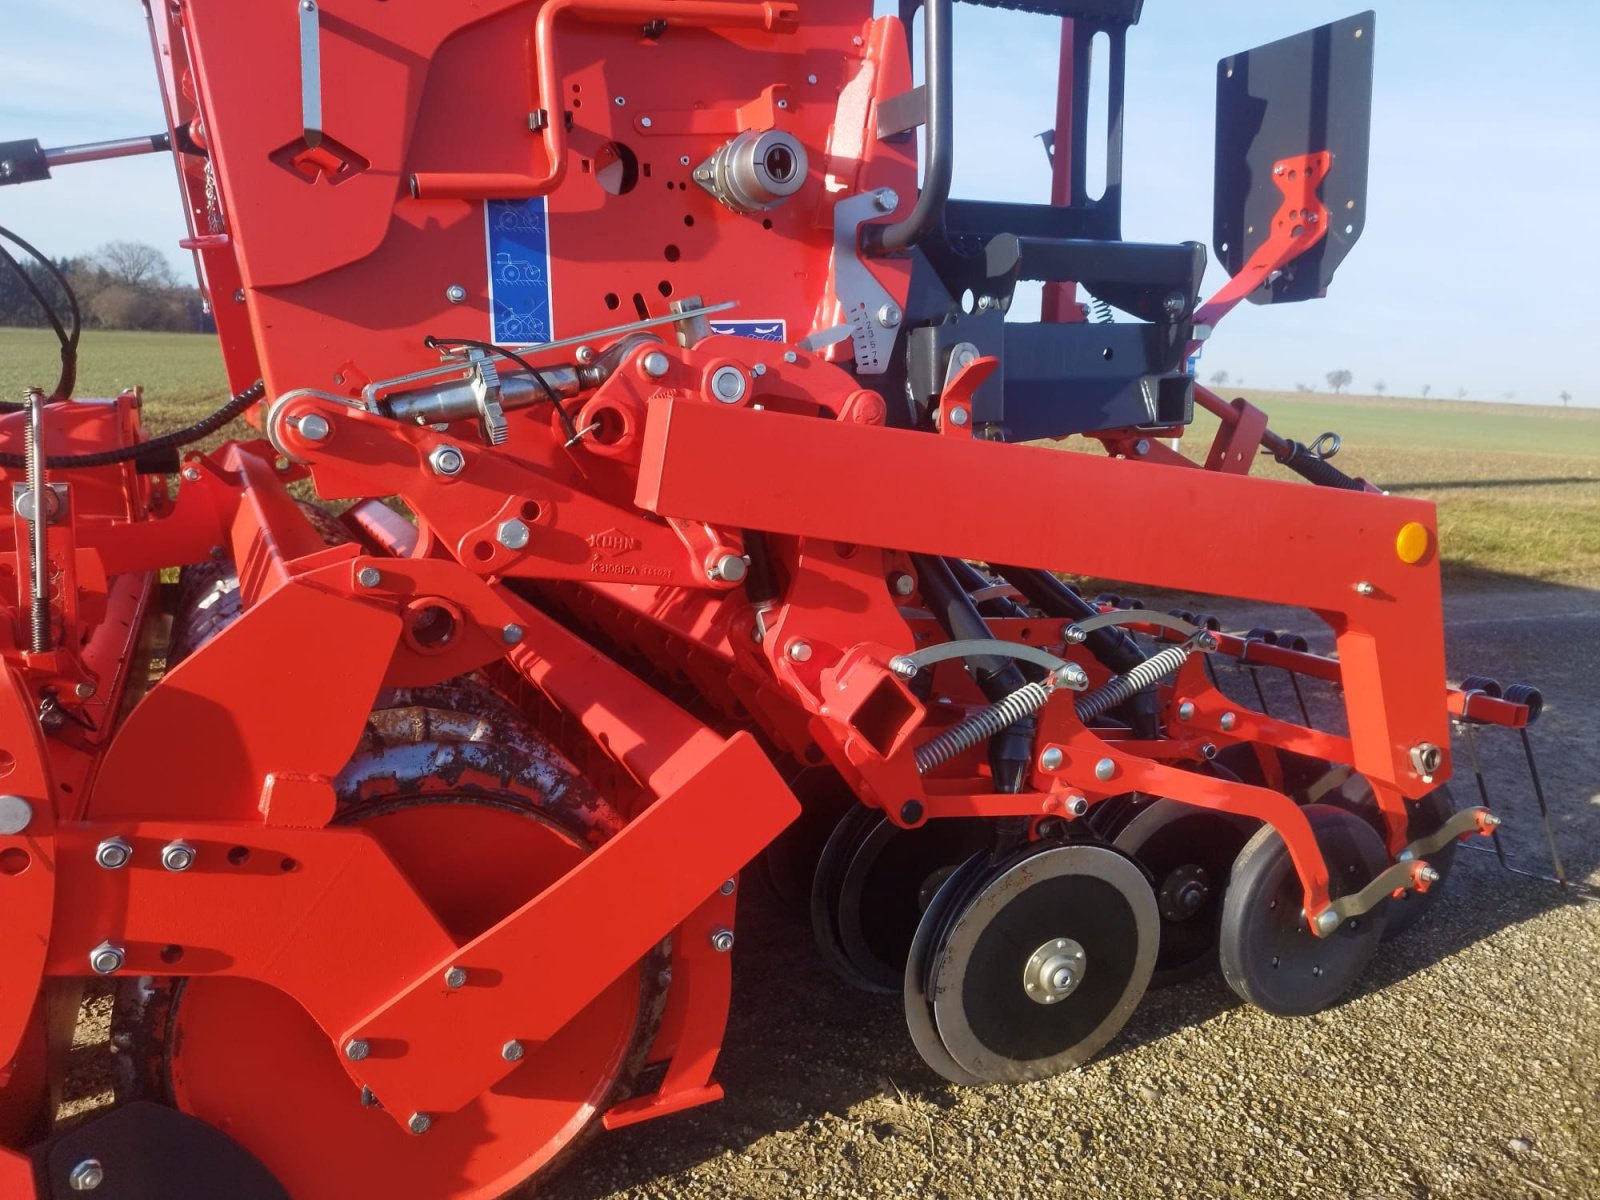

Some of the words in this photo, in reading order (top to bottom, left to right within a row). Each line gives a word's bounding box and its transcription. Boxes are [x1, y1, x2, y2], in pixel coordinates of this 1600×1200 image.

[866, 321, 872, 329] 2
[868, 330, 874, 338] 3
[872, 350, 877, 358] 7
[585, 533, 635, 550] KUHN
